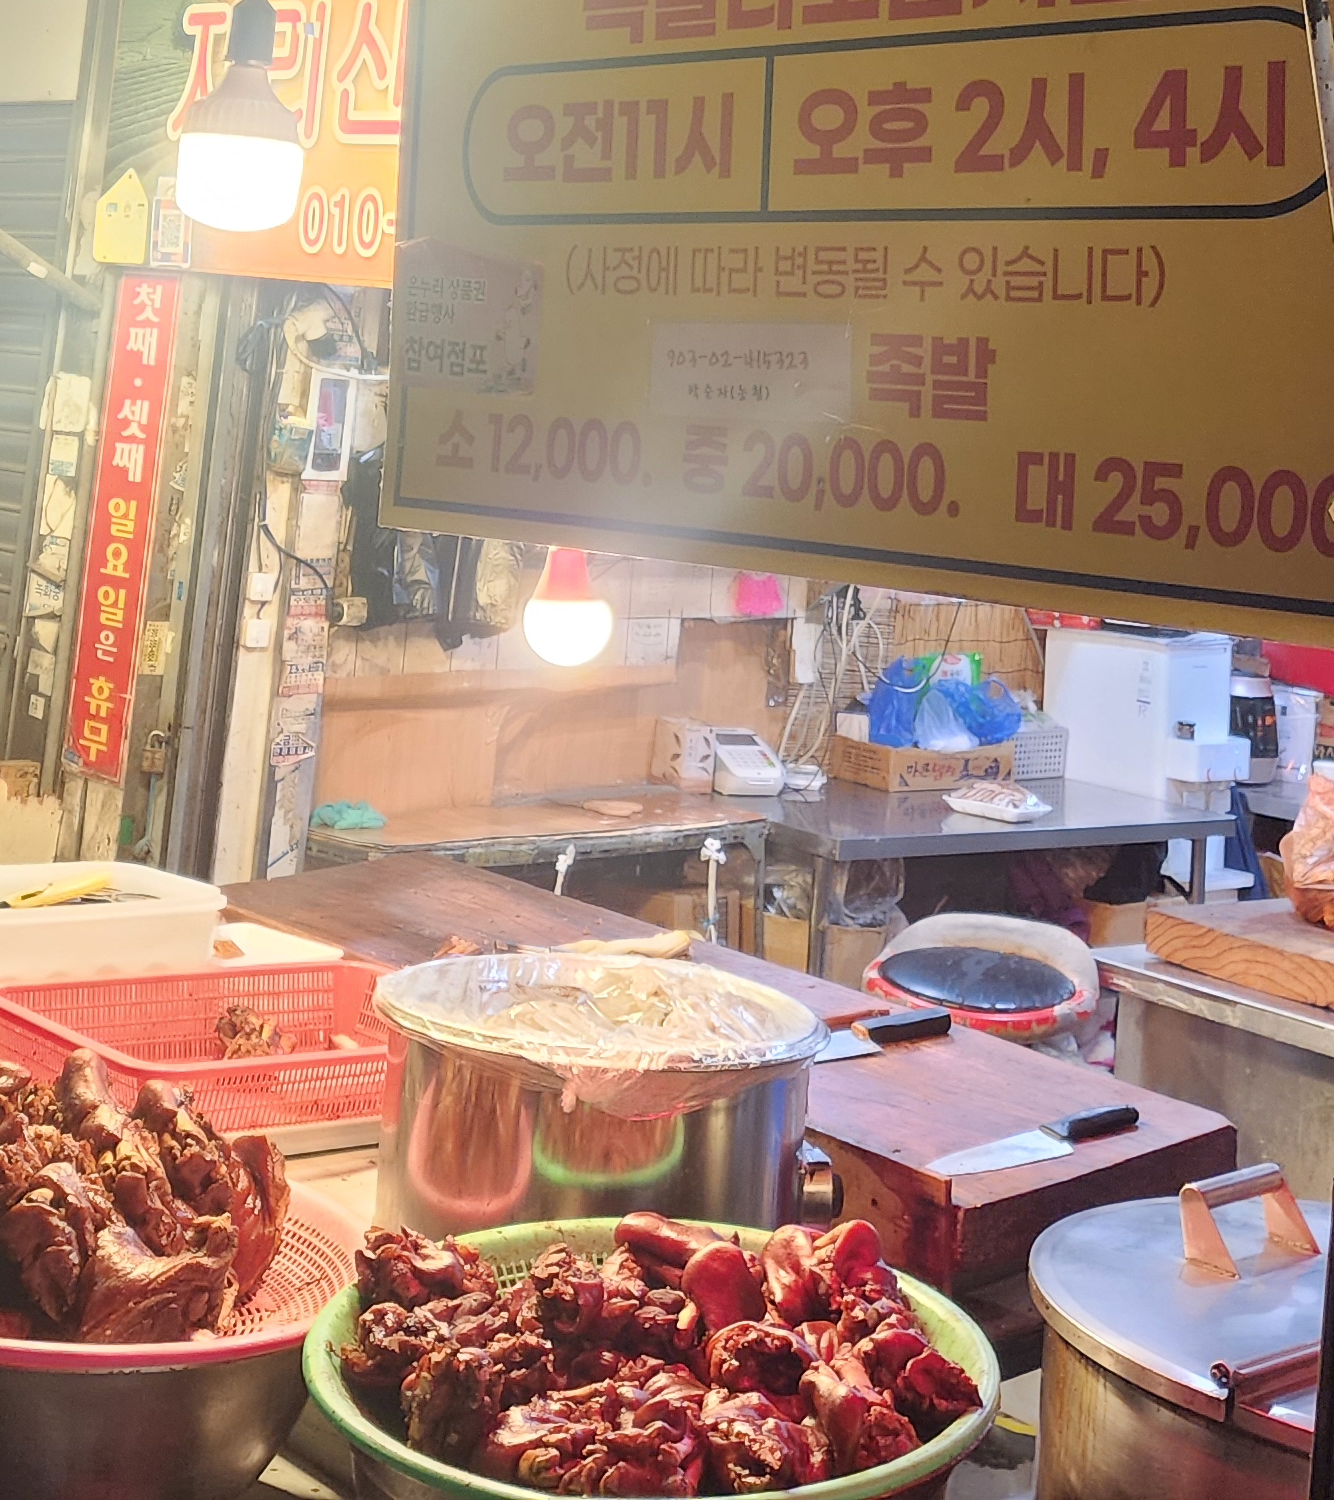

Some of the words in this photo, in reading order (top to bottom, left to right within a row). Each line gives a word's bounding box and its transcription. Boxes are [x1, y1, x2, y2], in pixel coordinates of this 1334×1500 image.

[503, 93, 734, 184] 오전11시
[793, 81, 933, 178] 오후
[954, 76, 1109, 179] 2시,
[1133, 61, 1287, 168] 4시
[566, 244, 679, 299] (사정에
[691, 246, 762, 298] 따라
[774, 245, 888, 300] 변동될
[900, 250, 945, 300] 수
[958, 245, 1166, 307] 있습니다)
[126, 283, 164, 367] 첫째
[405, 336, 487, 377] 참여점포
[867, 333, 997, 421] 족발
[111, 398, 150, 484] 셋째
[436, 411, 476, 469] 소
[682, 423, 729, 491] 중
[1015, 451, 1074, 530] 대
[94, 497, 137, 663] 일요일은
[78, 675, 116, 763] 휴무
